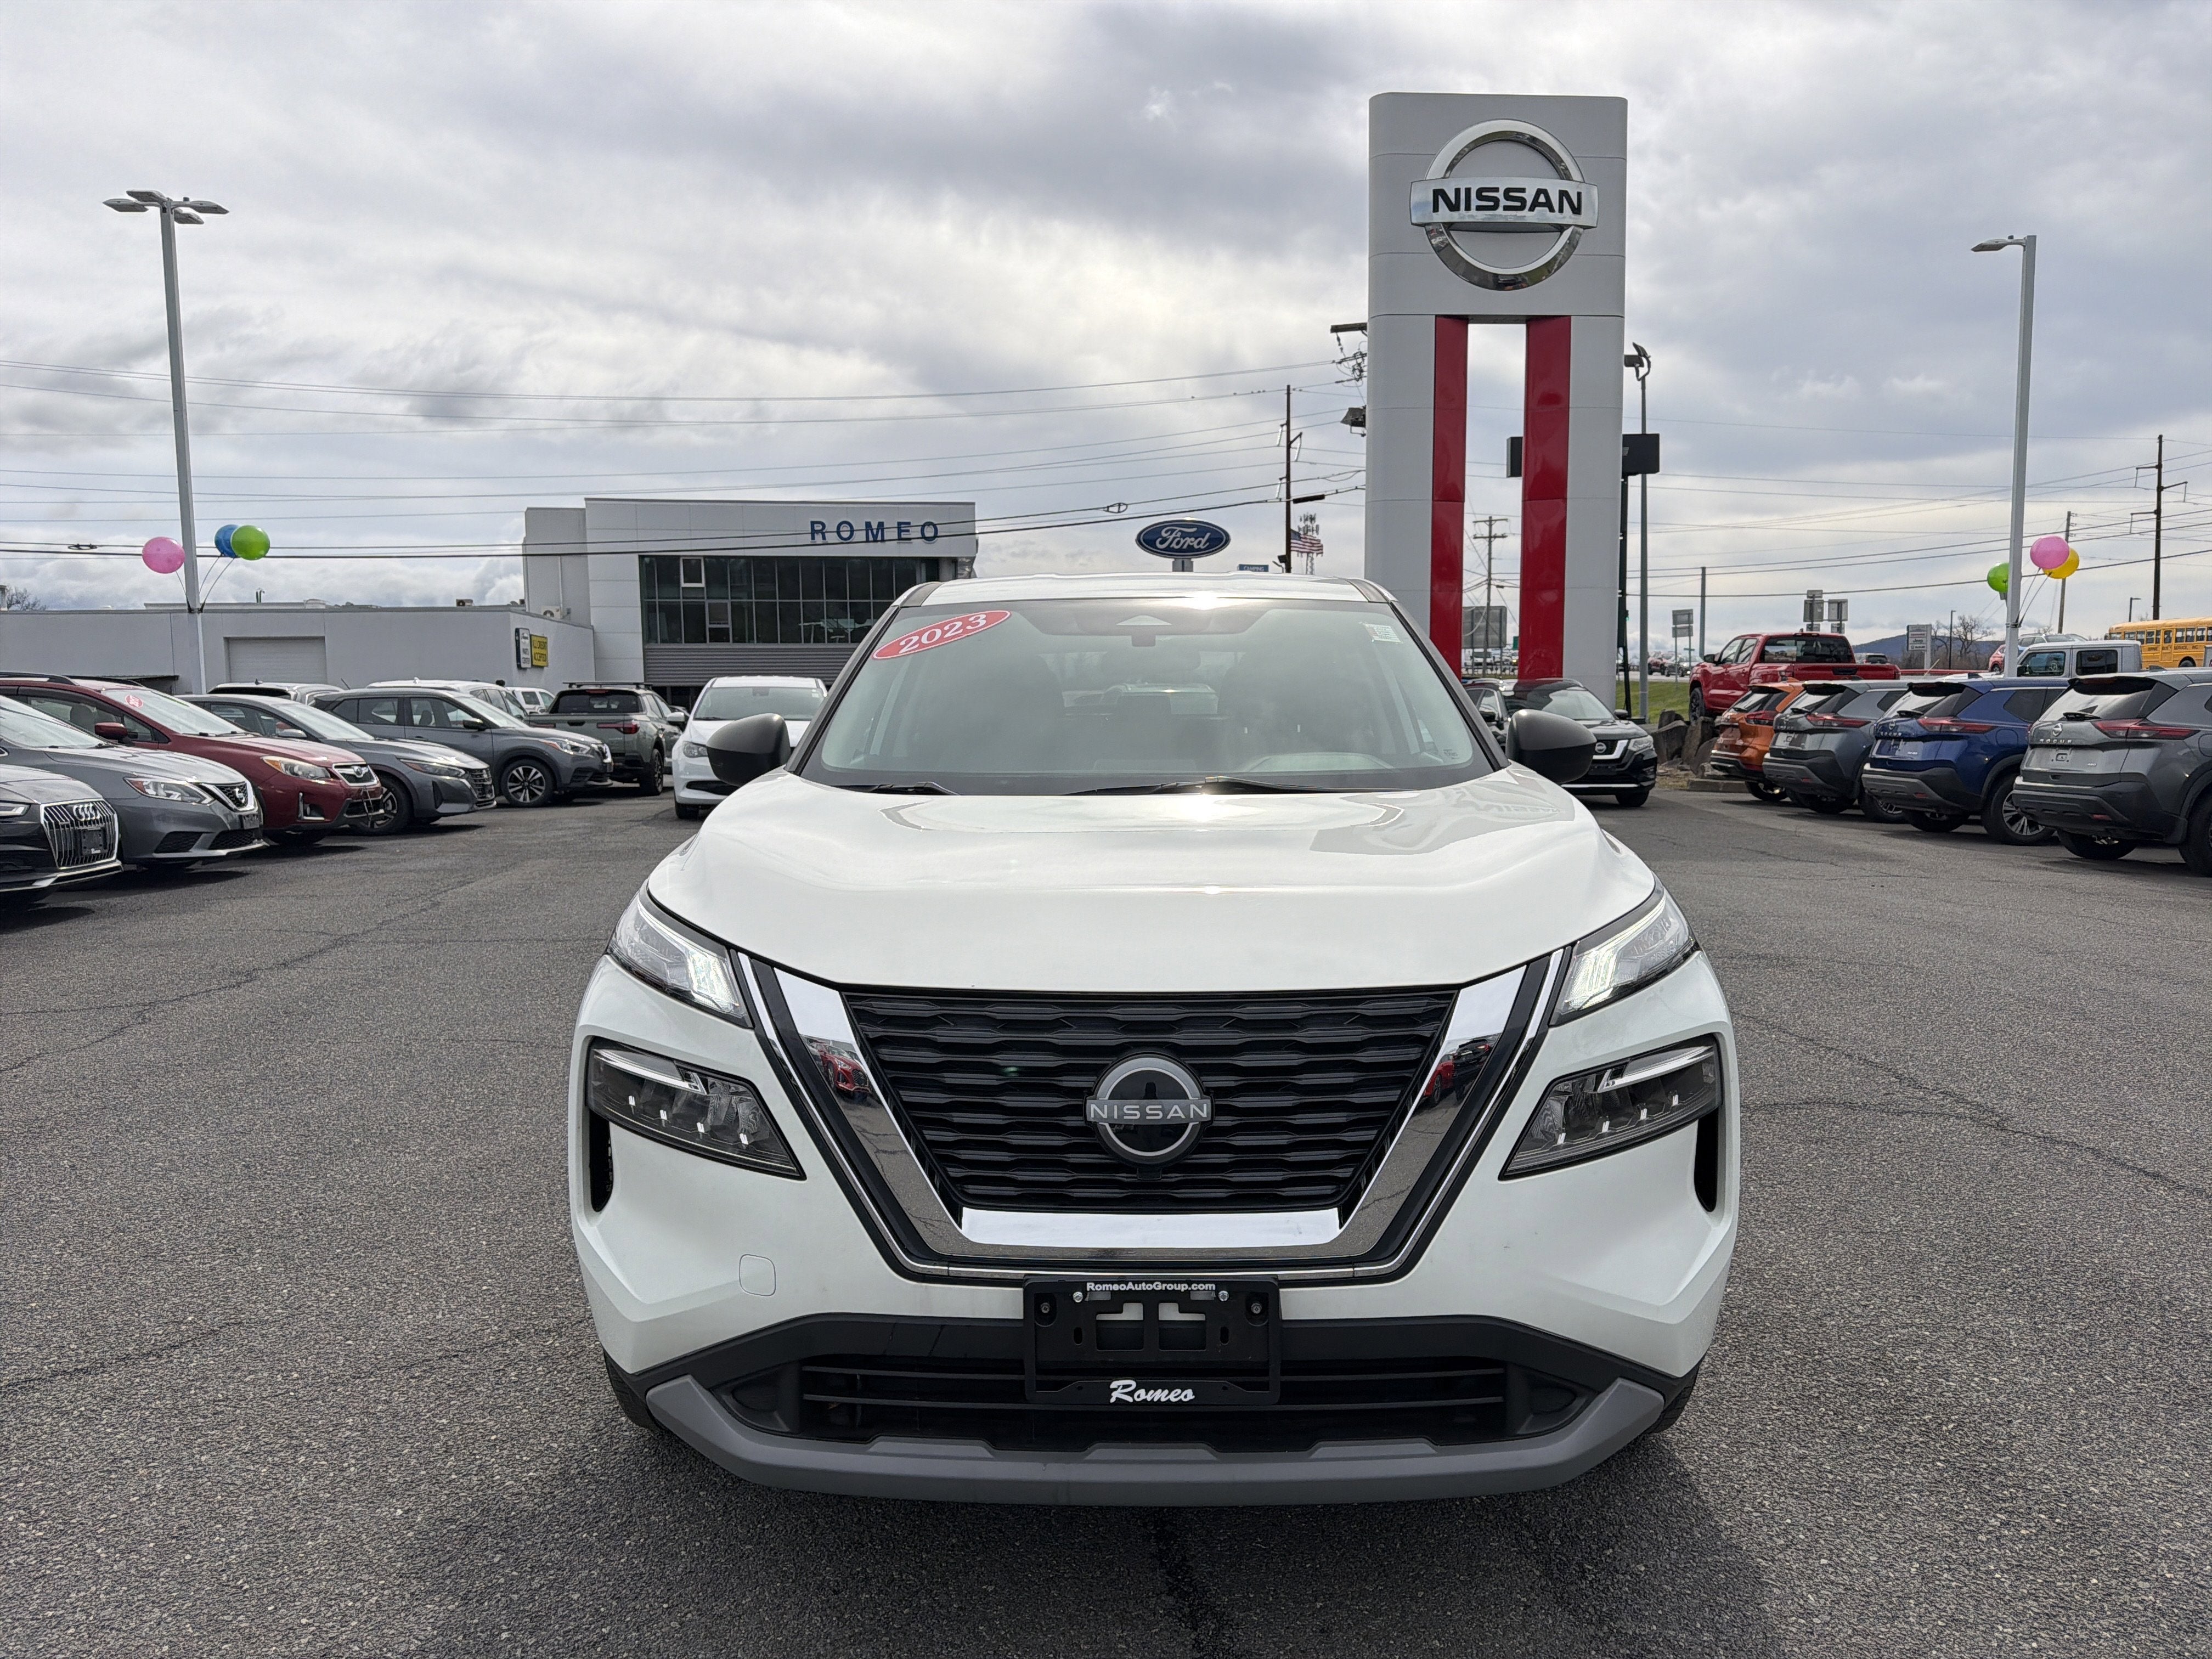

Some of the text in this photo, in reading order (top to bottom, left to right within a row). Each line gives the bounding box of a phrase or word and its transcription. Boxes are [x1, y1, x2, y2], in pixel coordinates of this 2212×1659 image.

[1432, 187, 1582, 216] NISSAN
[810, 520, 939, 542] ROMEO
[1155, 526, 1211, 549] Ford
[898, 613, 987, 654] 2023
[1090, 1103, 1207, 1120] NISSAN
[1086, 1282, 1216, 1292] RomeoAutoGroup.com
[1109, 1379, 1195, 1403] Romeo
